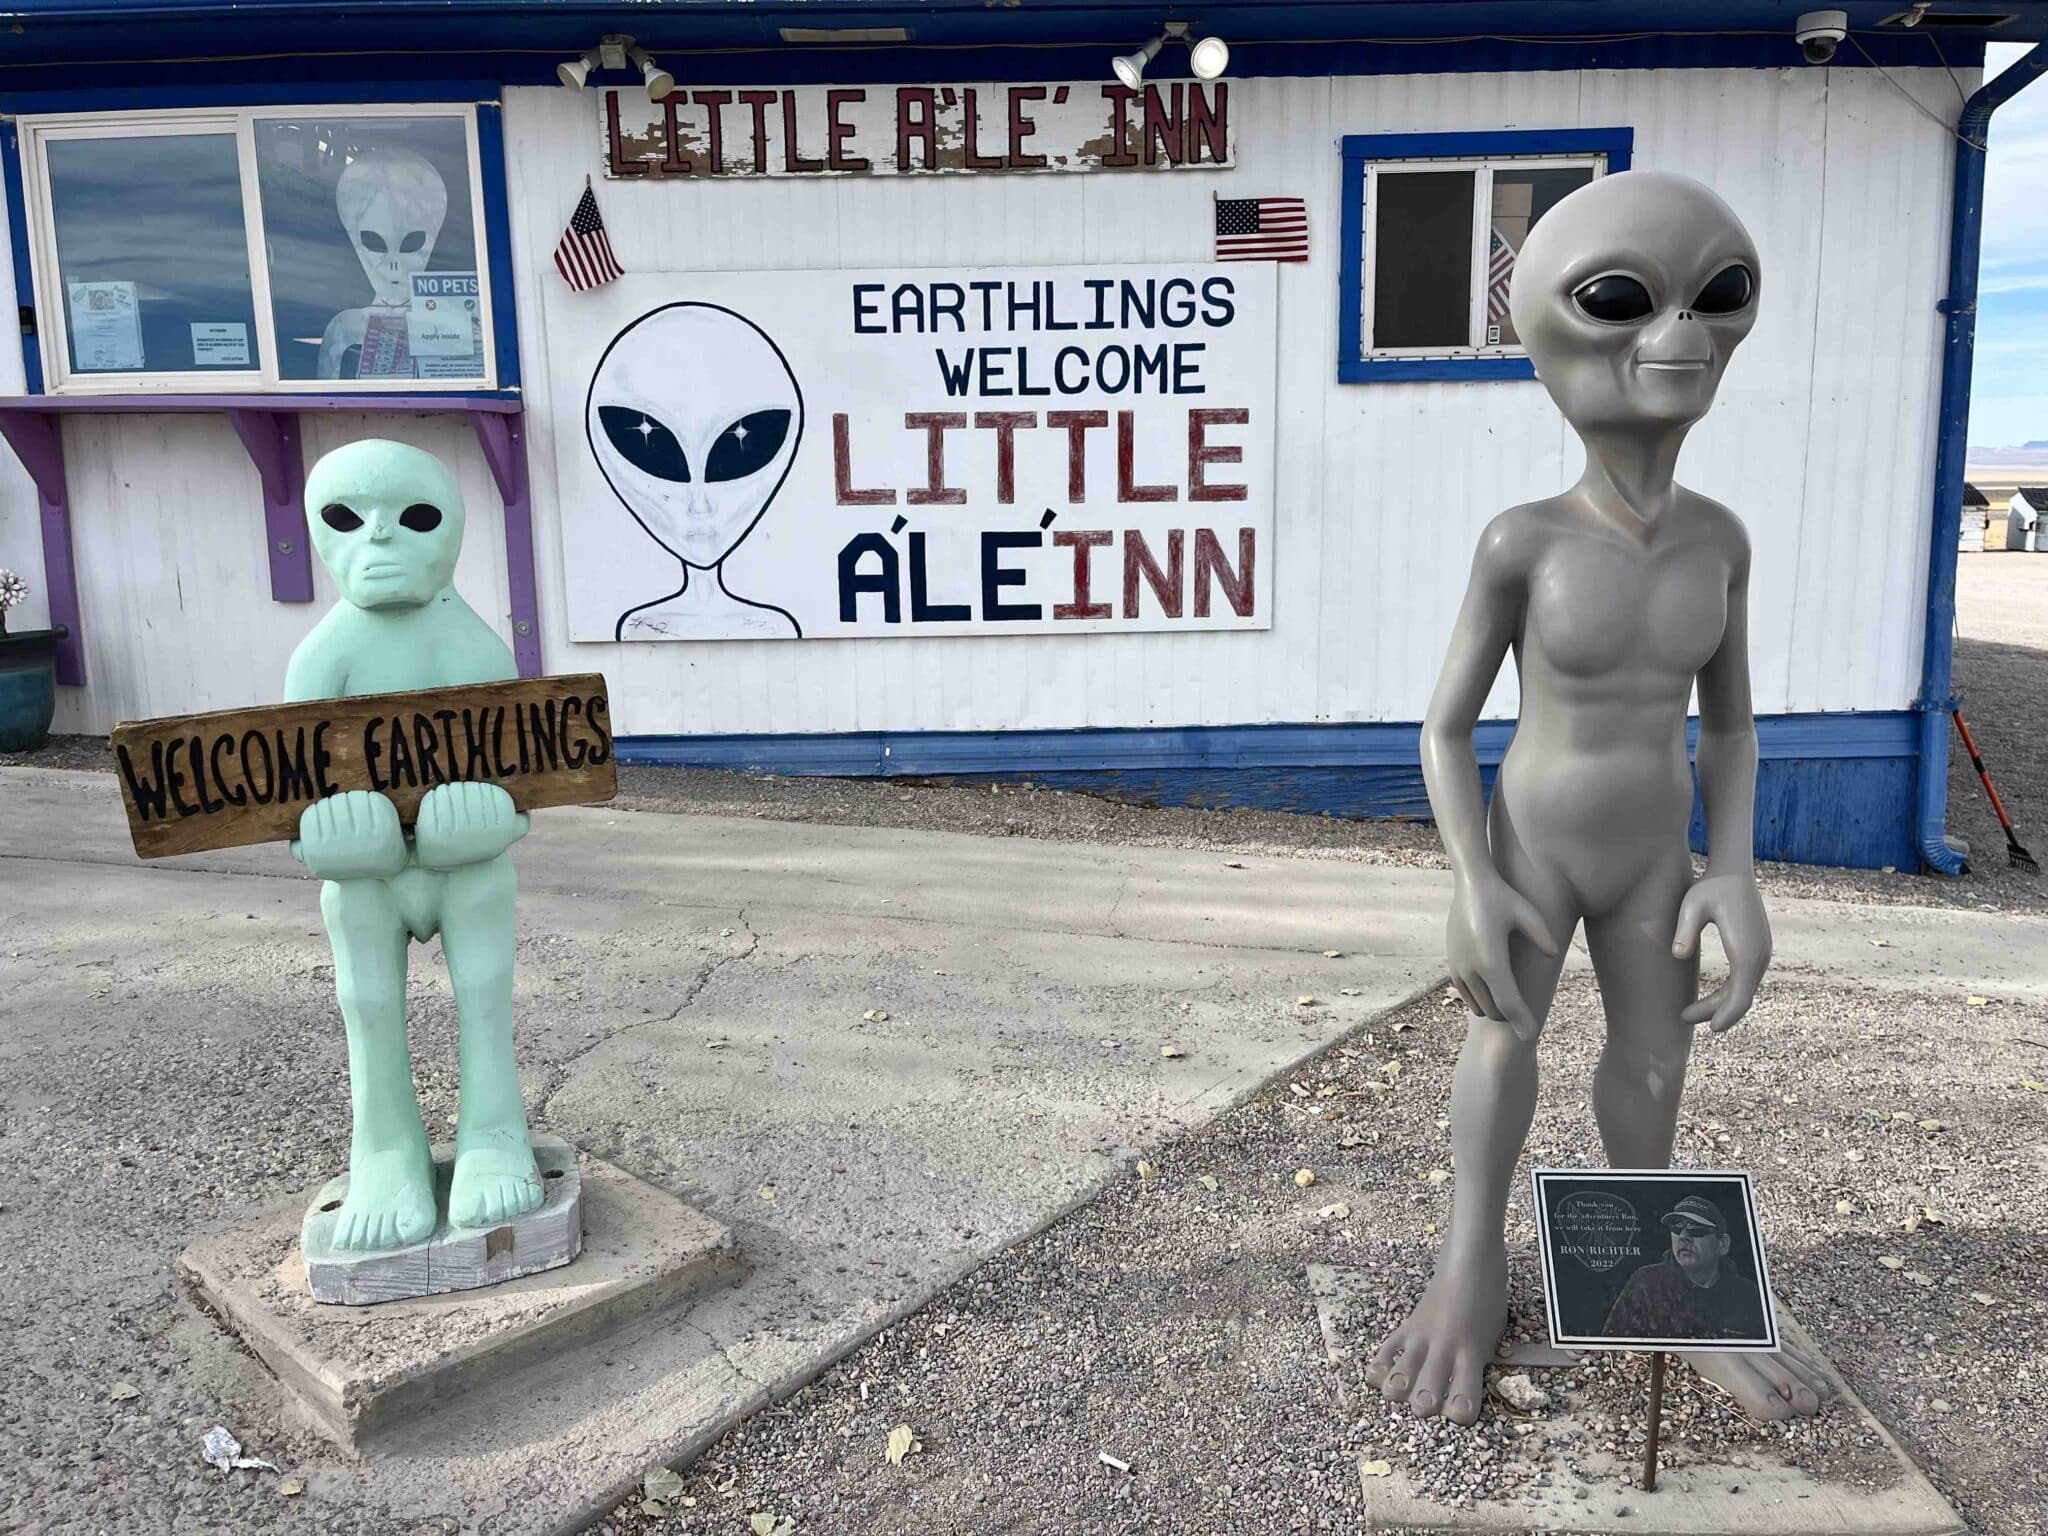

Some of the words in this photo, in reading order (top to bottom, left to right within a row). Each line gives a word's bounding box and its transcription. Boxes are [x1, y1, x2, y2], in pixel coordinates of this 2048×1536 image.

[604, 90, 870, 174] LITTLE
[1100, 82, 1230, 167] INN
[417, 279, 438, 294] NO
[442, 279, 478, 294] PETS
[852, 276, 1236, 334] EARTHLINGS
[935, 342, 1207, 397] WELCOME
[832, 407, 1251, 506] LITTLE
[117, 720, 340, 821] WELCOME
[363, 695, 611, 791] EARTHLINGS
[1576, 1200, 1598, 1208] Thank
[1560, 1245, 1585, 1254] RON
[1589, 1246, 1641, 1256] RICHTER
[1590, 1260, 1614, 1268] 2022
